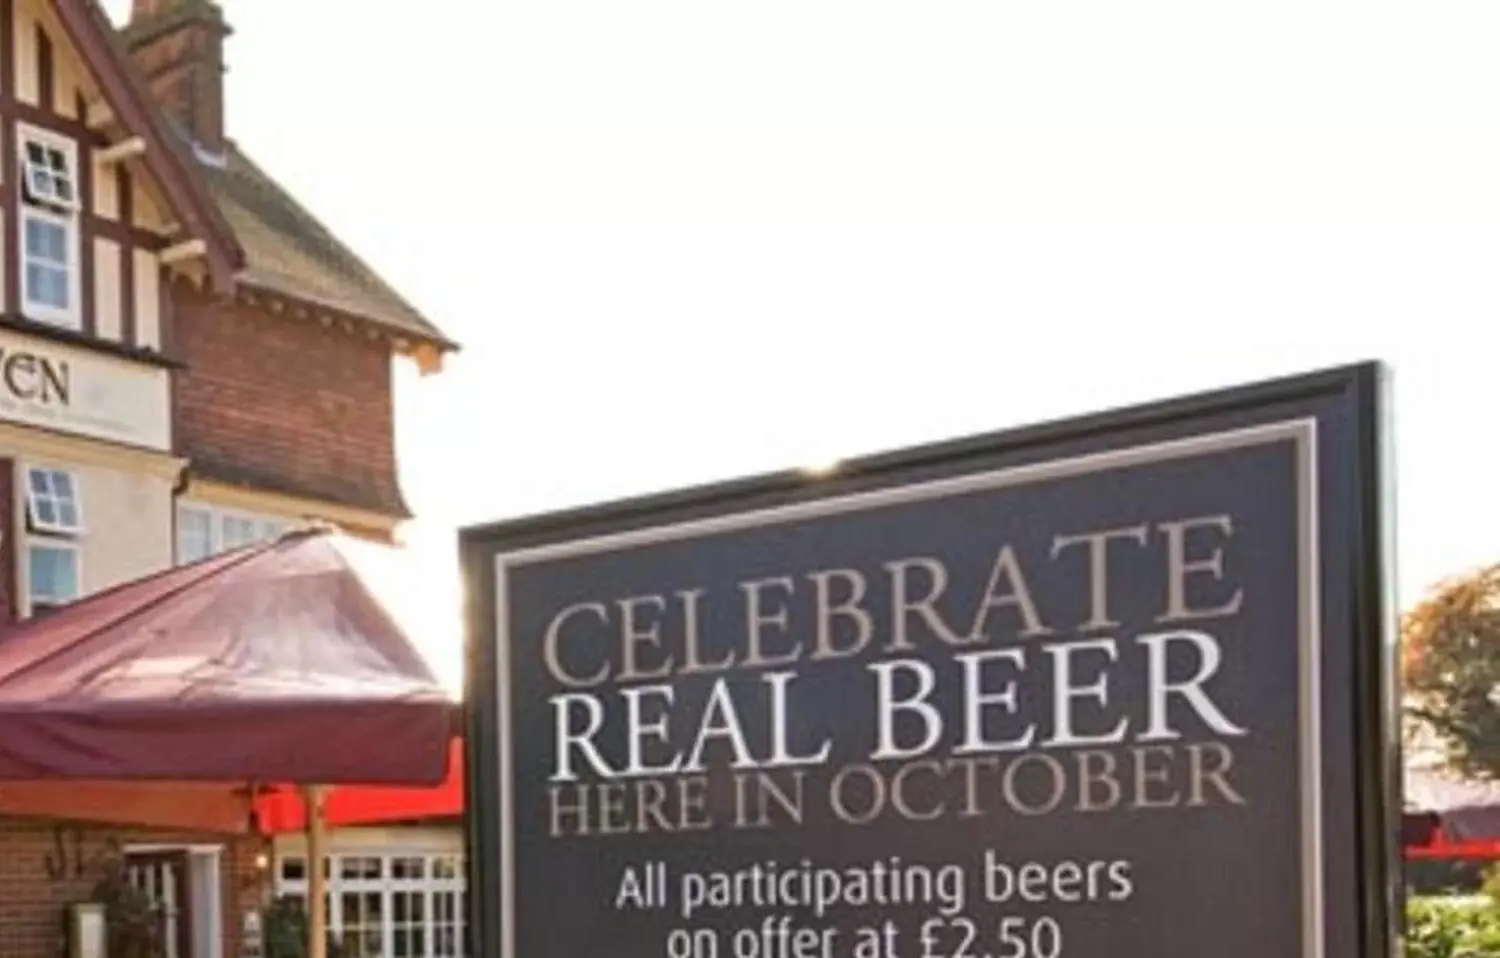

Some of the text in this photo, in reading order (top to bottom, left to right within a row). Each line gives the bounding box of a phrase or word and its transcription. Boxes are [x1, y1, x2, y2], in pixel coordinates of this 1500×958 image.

[543, 515, 1244, 688] CELEBRATE
[549, 628, 1248, 782] REAL BEER
[549, 742, 1246, 838] HERE IN OCTOBER
[616, 849, 1134, 916] All participating beers
